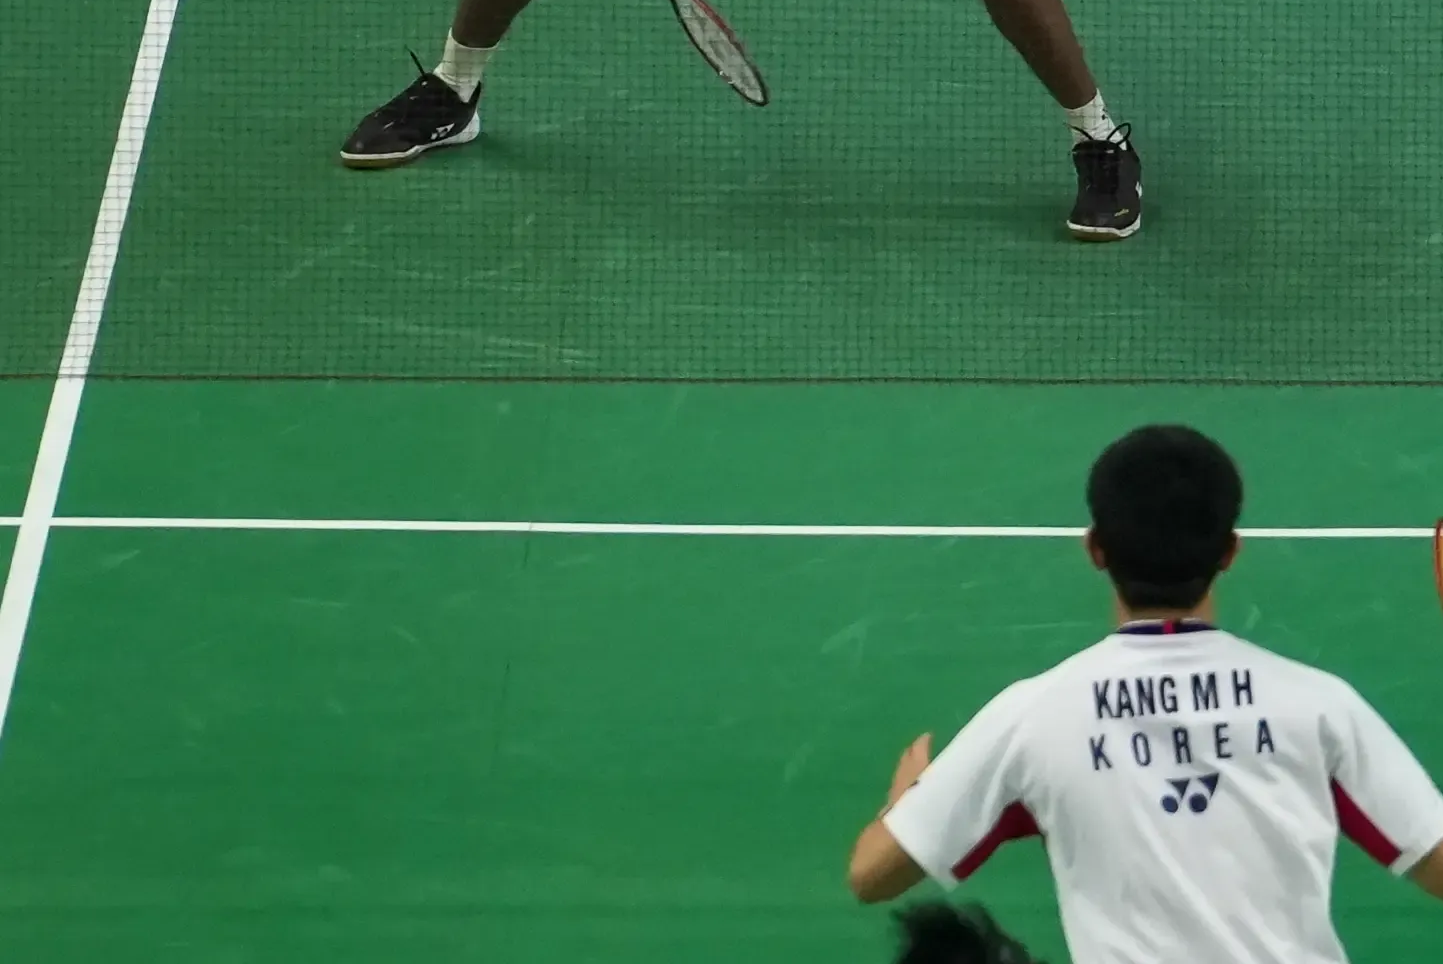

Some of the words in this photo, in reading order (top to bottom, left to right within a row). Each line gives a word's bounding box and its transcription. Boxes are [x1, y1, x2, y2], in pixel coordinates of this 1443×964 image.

[1092, 674, 1179, 719] KANG
[1190, 671, 1220, 712] M
[1231, 668, 1254, 707] H
[1089, 718, 1275, 771] KOREA
